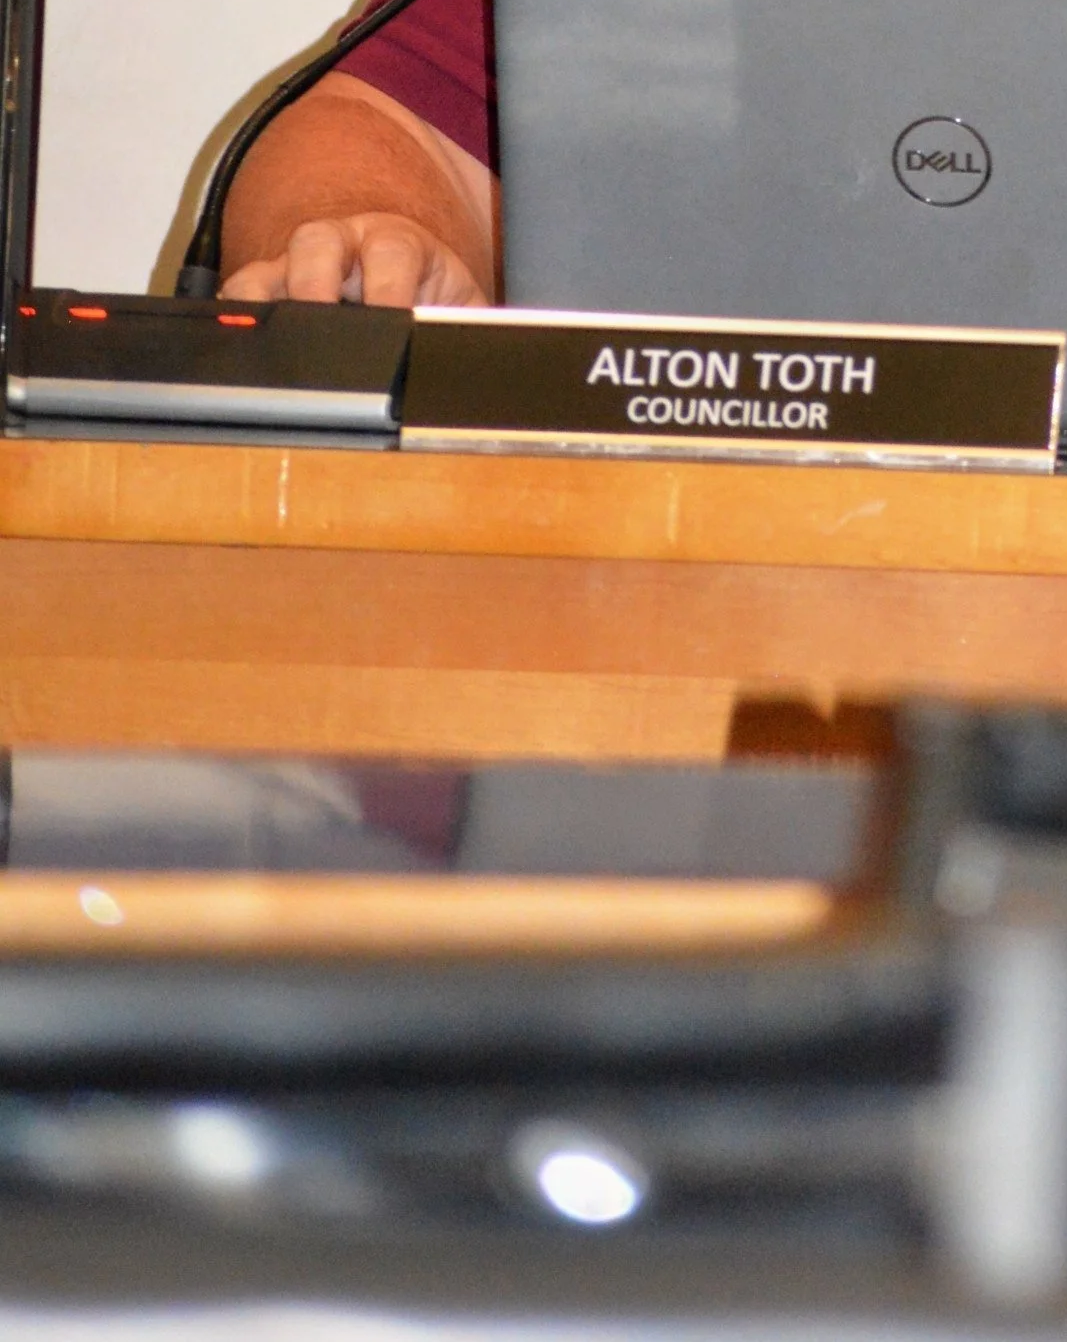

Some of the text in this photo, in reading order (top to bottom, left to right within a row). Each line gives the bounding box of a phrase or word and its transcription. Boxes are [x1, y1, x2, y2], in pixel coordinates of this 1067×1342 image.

[905, 150, 982, 174] DELL
[586, 346, 876, 395] ALTON TOTH
[626, 395, 829, 430] COUNCILLOR
